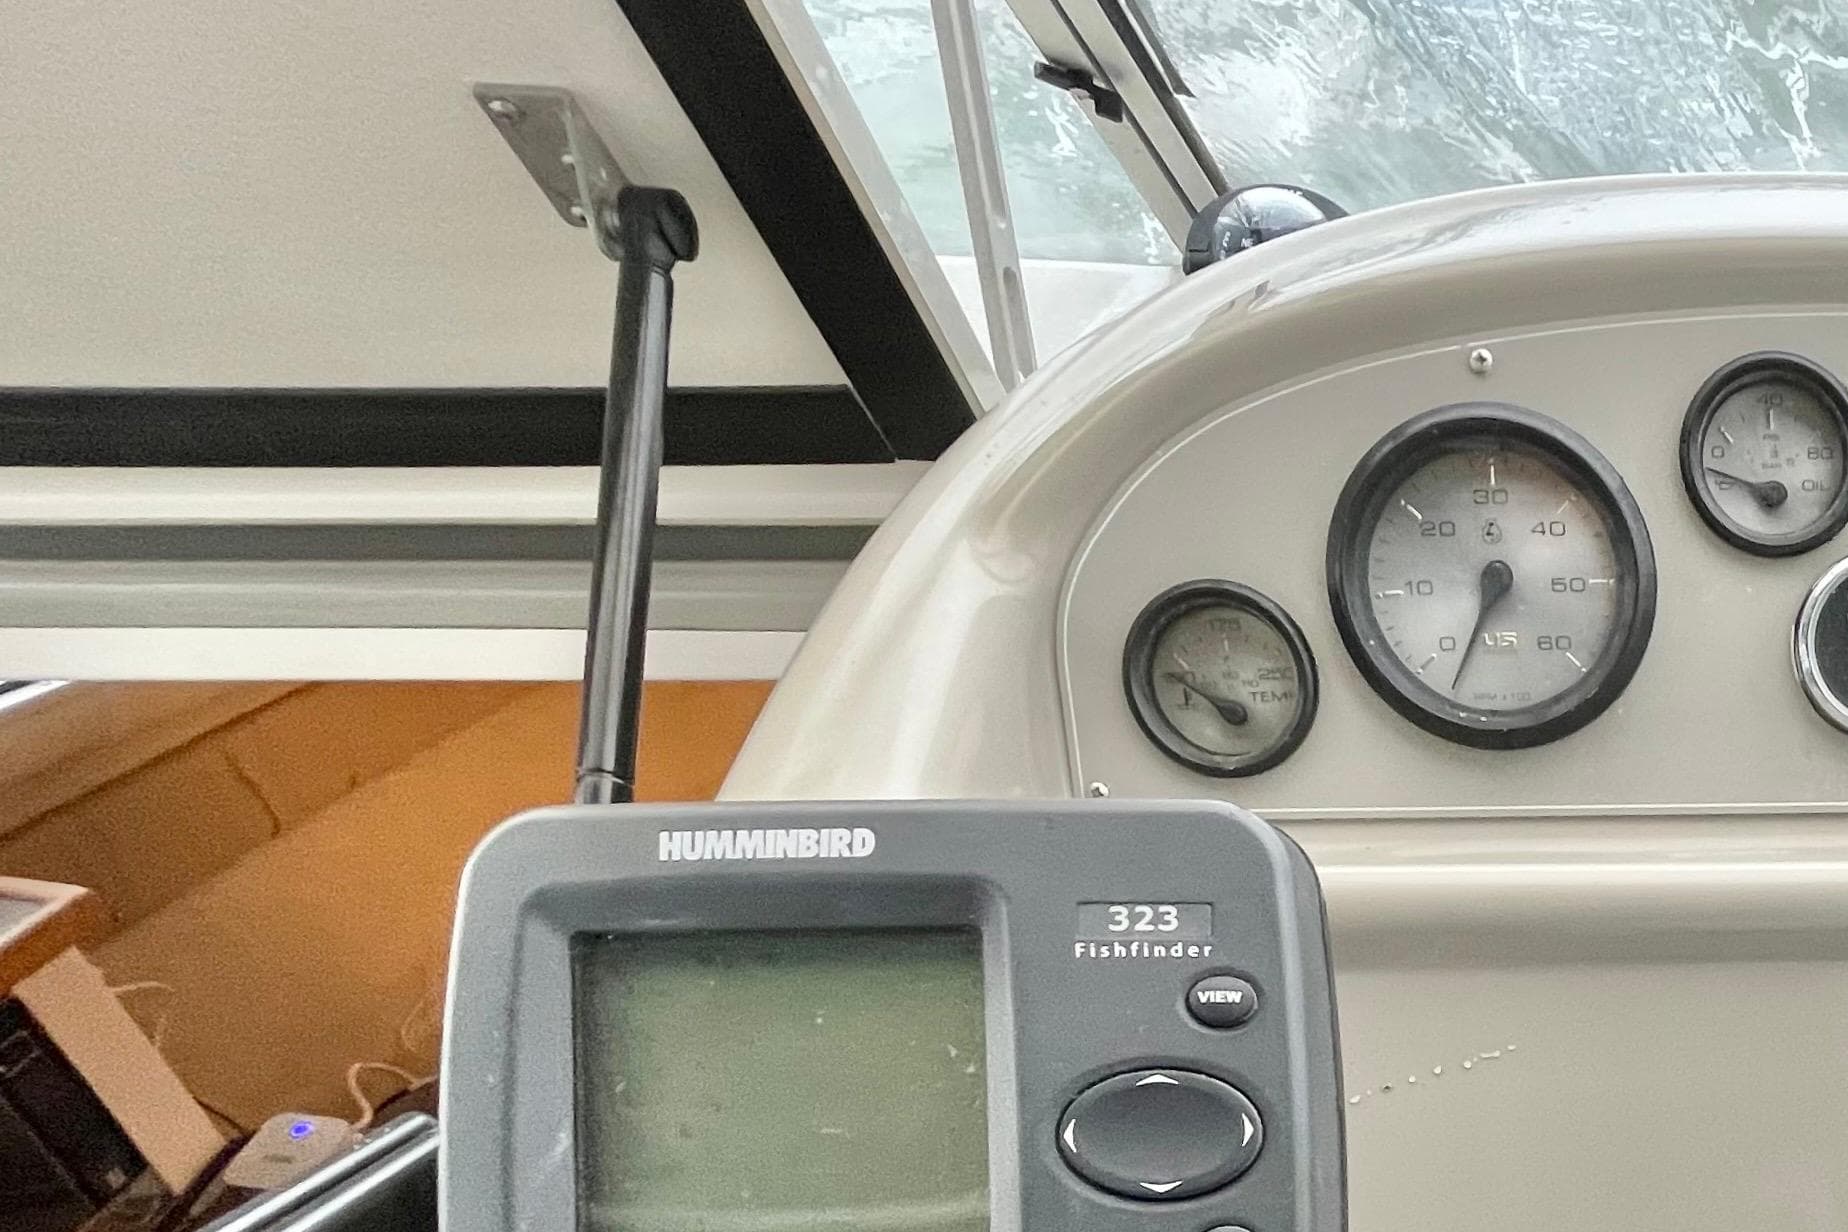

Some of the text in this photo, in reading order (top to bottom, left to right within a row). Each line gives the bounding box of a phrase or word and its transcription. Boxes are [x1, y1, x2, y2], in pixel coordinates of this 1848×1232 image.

[1472, 489, 1509, 505] 30
[1419, 520, 1456, 538] 20
[1530, 520, 1566, 537] 40
[1404, 579, 1434, 596] 10
[1550, 577, 1586, 593] 50
[1439, 635, 1457, 652] 0
[1536, 635, 1572, 651] 60
[658, 827, 876, 862] HUMMINBIRD
[1106, 904, 1180, 932] 323
[1073, 941, 1214, 959] Fishfinder
[1196, 989, 1244, 1005] VIEW
